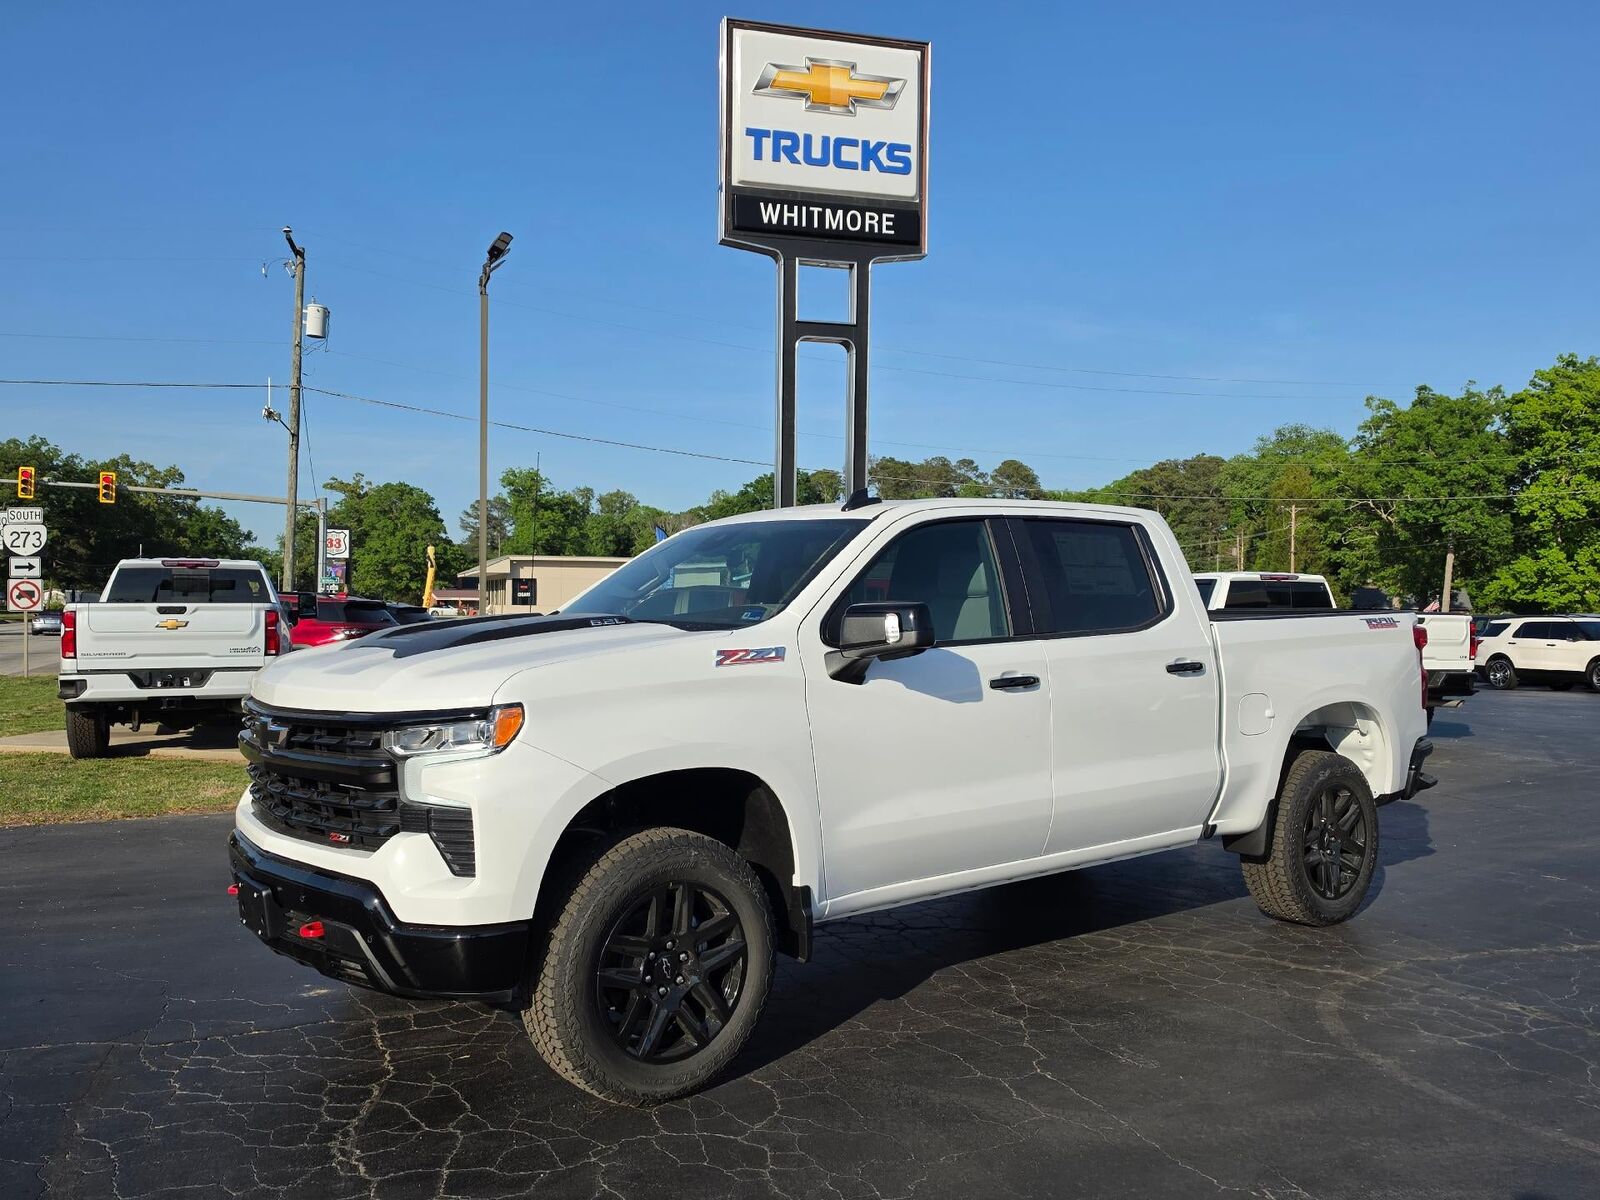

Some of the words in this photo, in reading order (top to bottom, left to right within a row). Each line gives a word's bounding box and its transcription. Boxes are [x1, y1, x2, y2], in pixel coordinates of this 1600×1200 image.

[745, 127, 912, 176] TRUCKS
[759, 202, 895, 235] WHITMORE
[9, 510, 41, 521] SOUTH
[10, 531, 42, 548] 273
[1360, 617, 1400, 626] TRAIL
[715, 646, 786, 667] Z71
